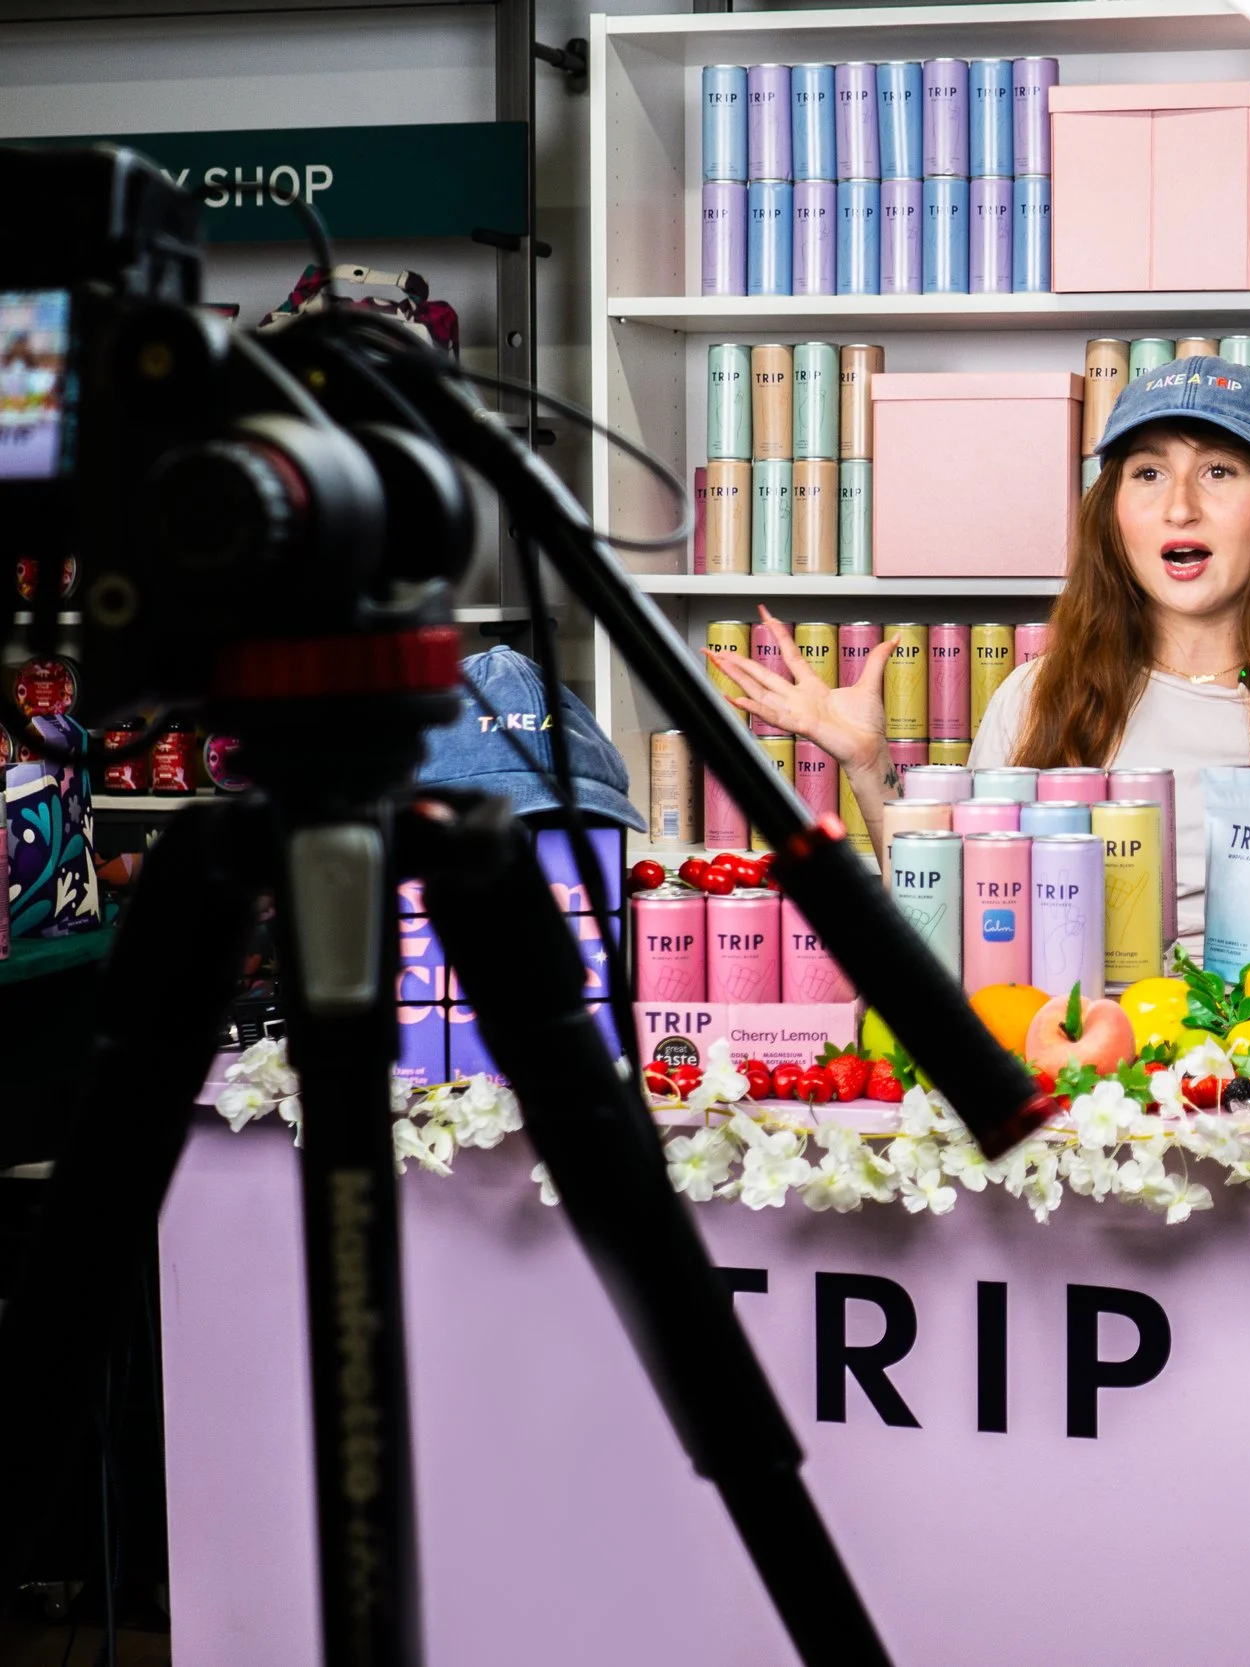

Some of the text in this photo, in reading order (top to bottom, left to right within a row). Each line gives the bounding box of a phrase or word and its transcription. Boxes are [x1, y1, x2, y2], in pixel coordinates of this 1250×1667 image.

[749, 91, 774, 103] TRIP
[797, 90, 825, 103] TRIP
[839, 90, 868, 102] TRIP
[883, 90, 911, 102] TRIP
[928, 86, 957, 98] TRIP
[977, 86, 1006, 99] TRIP
[1014, 85, 1041, 97] TRIP
[708, 92, 737, 104] TRIP
[204, 165, 334, 207] SHOP
[703, 208, 728, 220] TRIP
[753, 208, 781, 220] TRIP
[797, 207, 826, 219] TRIP
[844, 207, 873, 218] TRIP
[886, 206, 914, 218] TRIP
[929, 205, 958, 216] TRIP
[977, 205, 1007, 216] TRIP
[1020, 204, 1050, 215] TRIP
[712, 372, 740, 381] TRIP
[756, 374, 784, 383] TRIP
[795, 371, 821, 380] TRIP
[841, 373, 857, 381] RIP
[1089, 368, 1118, 378] TRIP
[1145, 373, 1242, 391] TAKE A TRIP
[711, 487, 738, 496] TRIP
[759, 487, 787, 496] TRIP
[795, 487, 820, 496] TRIP
[838, 488, 861, 498] TRIP
[798, 646, 829, 657] TRIP
[842, 647, 870, 657] TRIP
[890, 647, 919, 658] RIP
[933, 646, 960, 657] TRIP
[977, 647, 1008, 658] TRIP
[478, 713, 537, 733] TAKE
[798, 760, 825, 772] TRIP
[1106, 840, 1142, 857] RIP
[895, 869, 941, 889] TRIP
[976, 881, 1022, 898] TRIP
[1036, 883, 1079, 900] TRIP
[984, 919, 1014, 932] Calm
[647, 935, 694, 952] TRIP
[717, 934, 764, 951] TRIP
[793, 934, 824, 952] TR
[645, 1012, 712, 1034] TRIP
[731, 1030, 829, 1042] Cherry Lemon
[656, 1053, 697, 1067] taste
